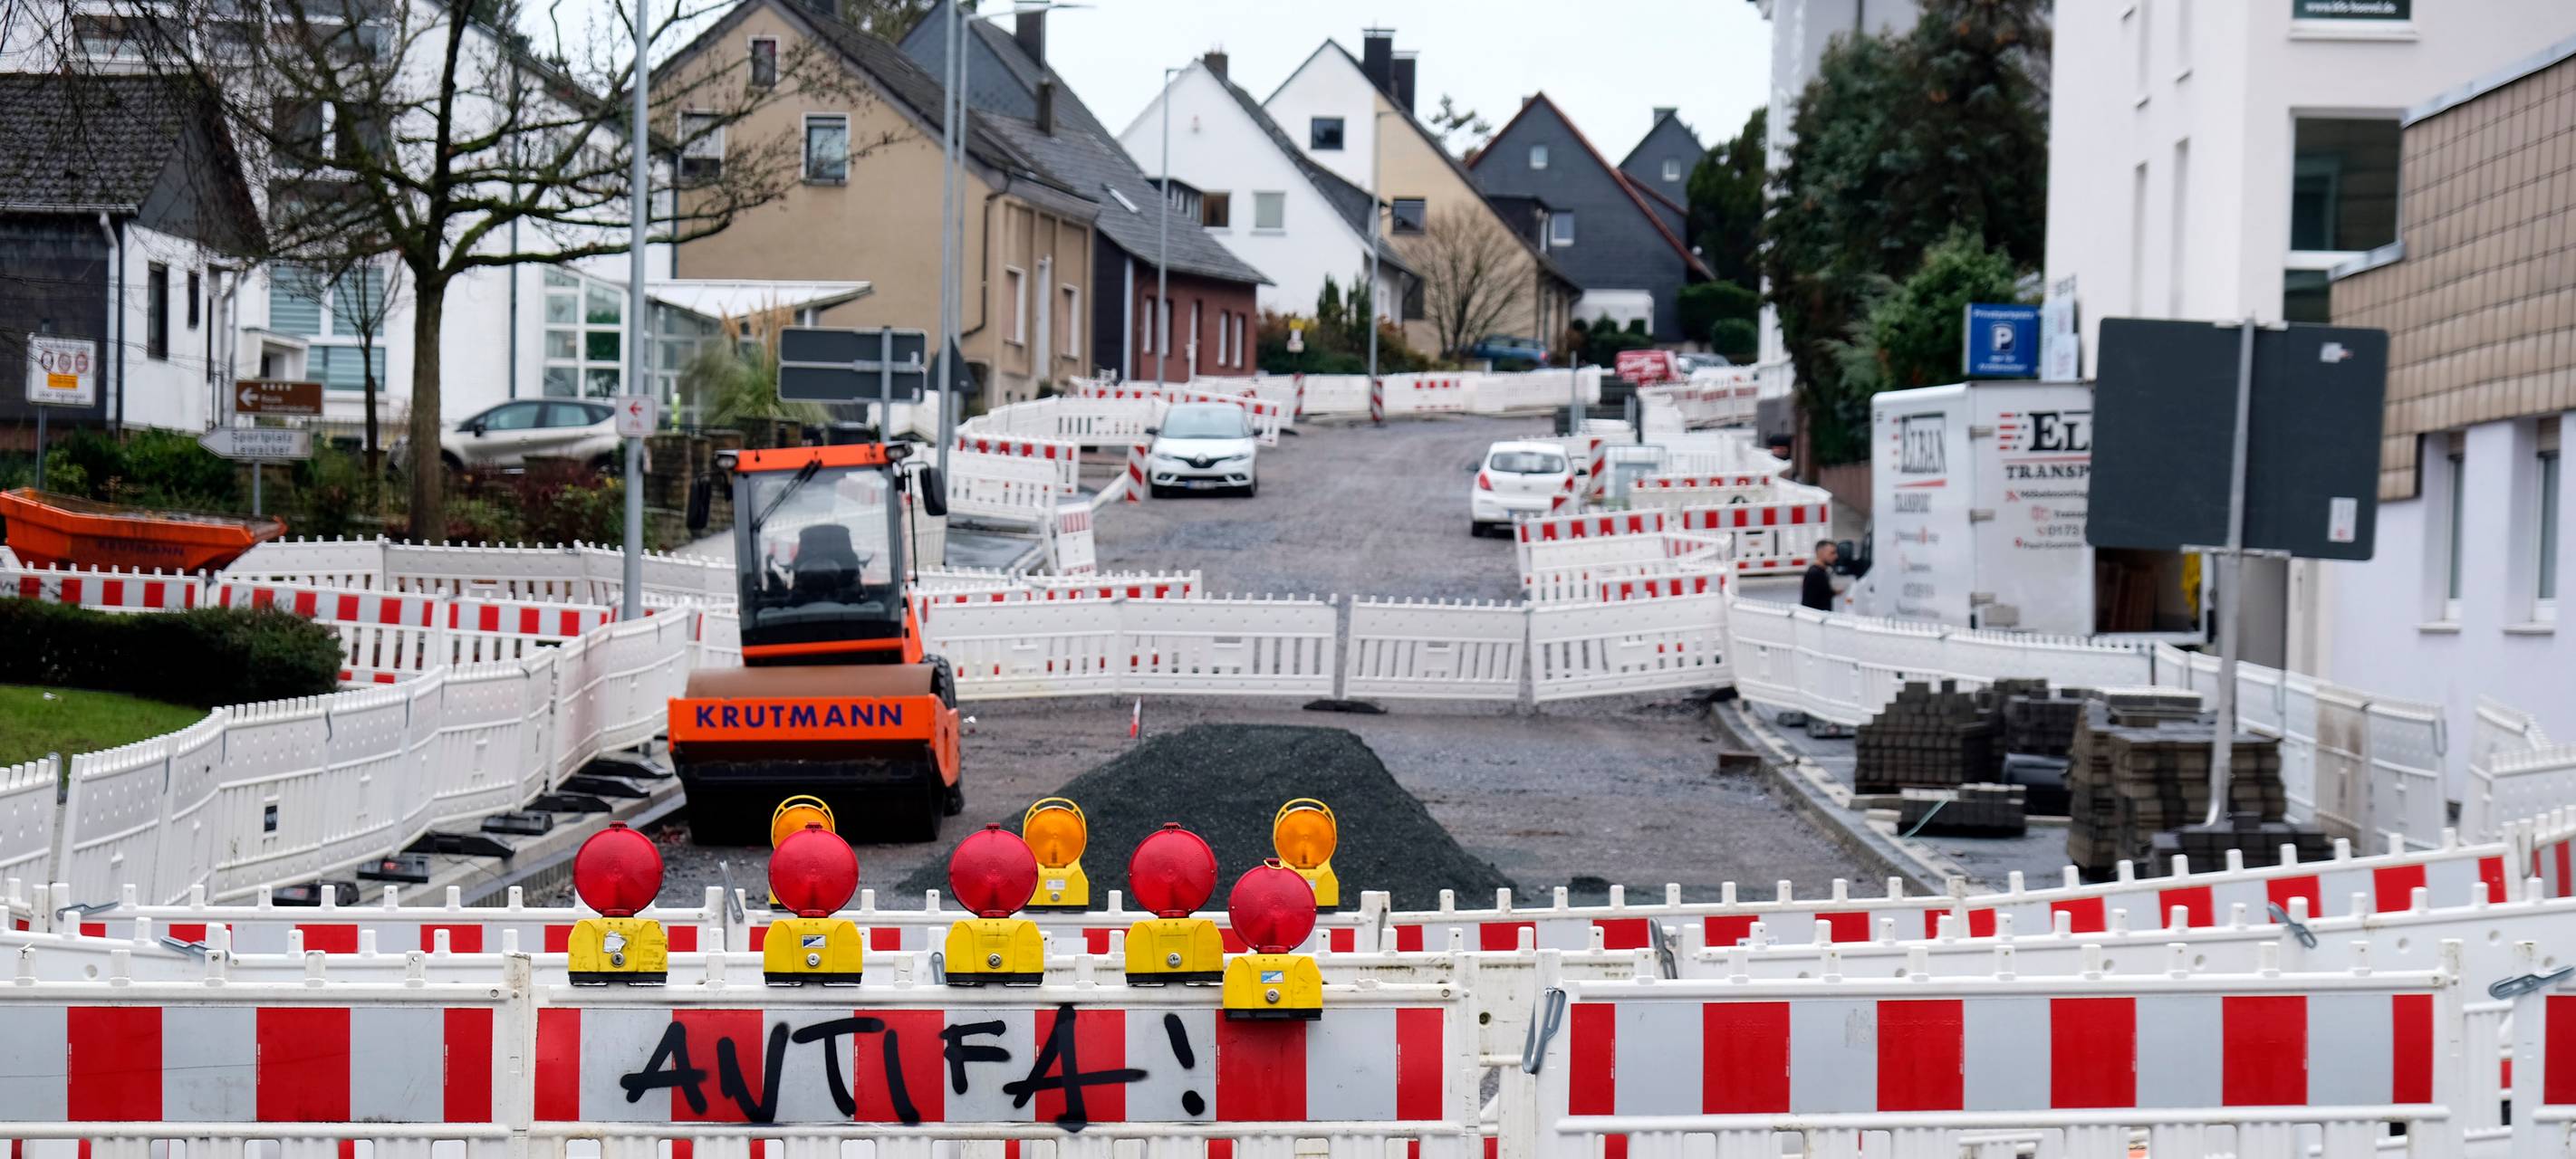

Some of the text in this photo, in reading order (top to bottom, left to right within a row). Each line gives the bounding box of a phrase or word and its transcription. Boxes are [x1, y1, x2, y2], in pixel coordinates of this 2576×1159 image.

[231, 430, 293, 445] Sportplatz
[696, 704, 902, 728] KRUTMANN
[620, 1003, 1206, 1132] ANTIFA!
